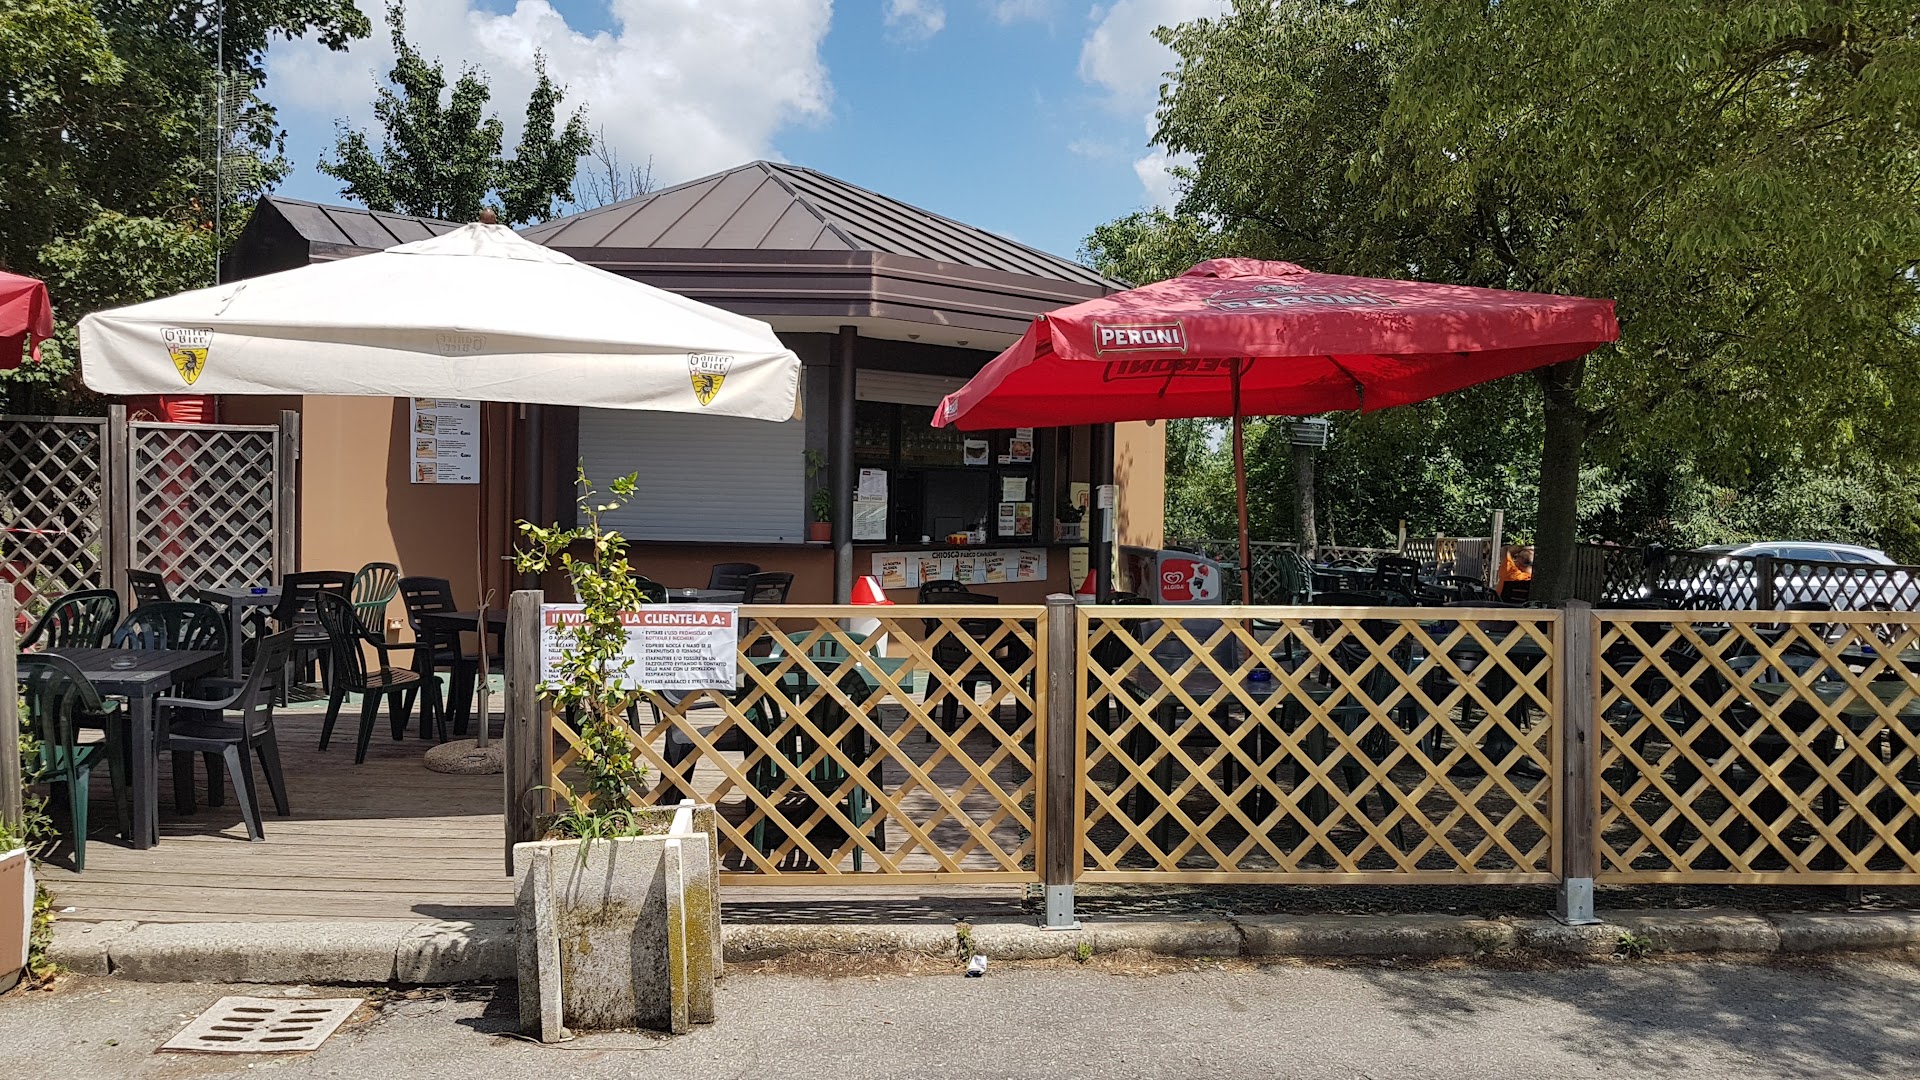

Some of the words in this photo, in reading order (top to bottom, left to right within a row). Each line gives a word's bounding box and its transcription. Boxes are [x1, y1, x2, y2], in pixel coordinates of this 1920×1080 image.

[1101, 328, 1180, 346] PERONI
[932, 551, 959, 559] CHIOSCO
[626, 613, 641, 624] LA
[644, 613, 708, 625] CLIENTELA
[711, 614, 726, 625] A:
